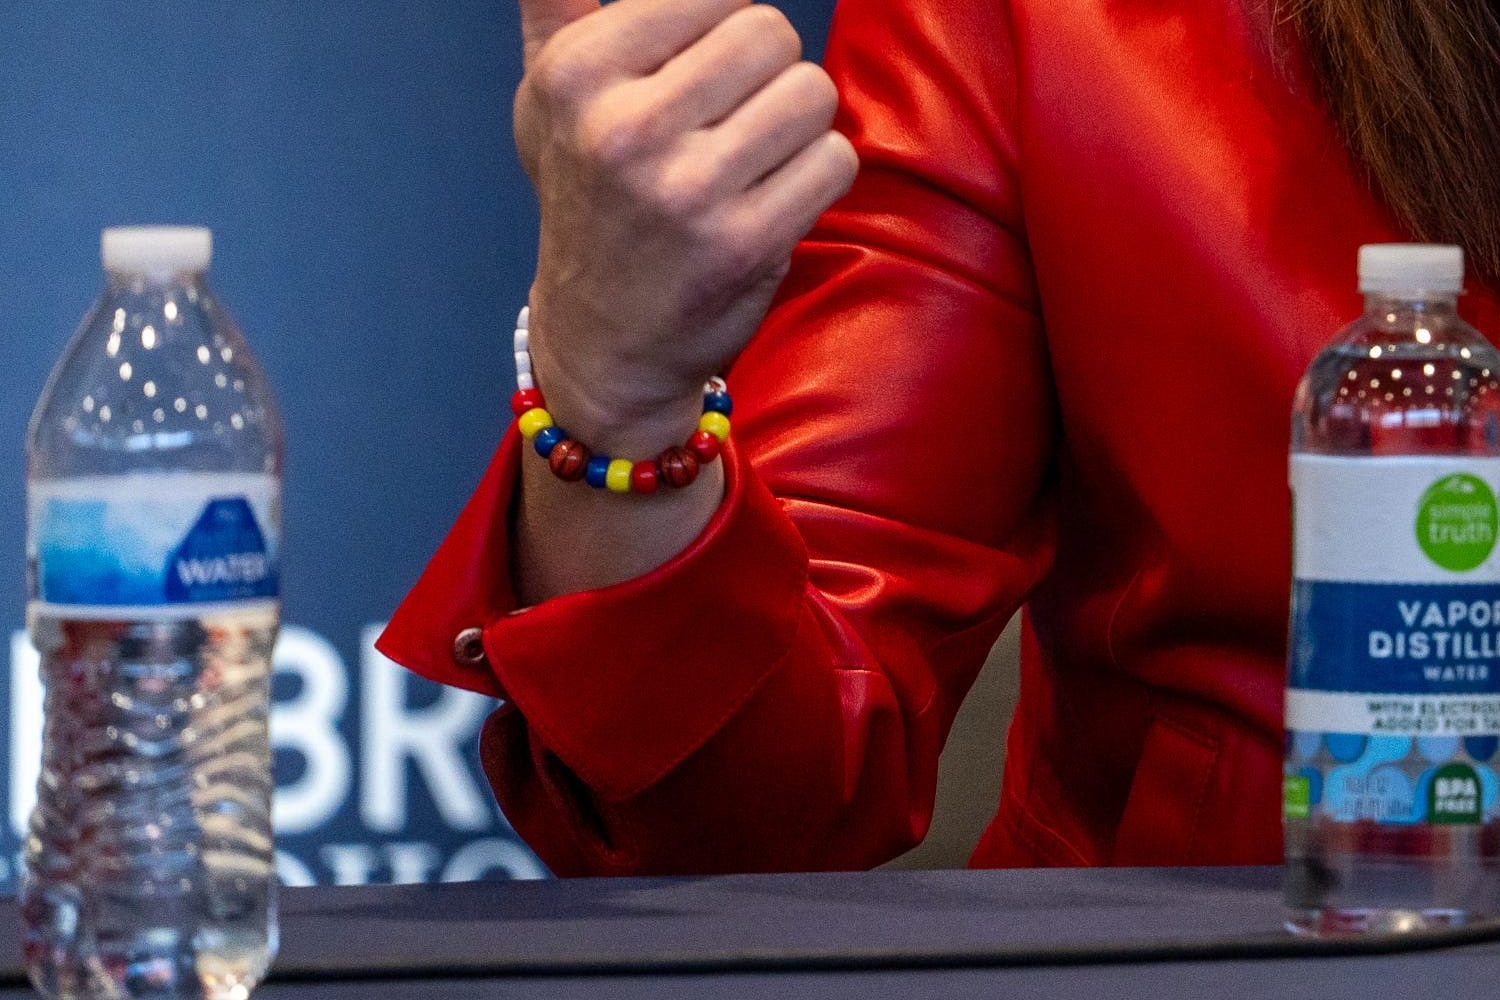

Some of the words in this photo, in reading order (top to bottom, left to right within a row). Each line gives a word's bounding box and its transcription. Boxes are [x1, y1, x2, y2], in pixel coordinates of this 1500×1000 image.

[1429, 521, 1493, 544] truth
[1423, 665, 1489, 682] WATER
[1367, 700, 1414, 714] WITH
[1372, 716, 1439, 731] ADDED
[1443, 716, 1478, 731] FOR
[1434, 776, 1478, 797] BPA
[1434, 798, 1478, 814] FREE
